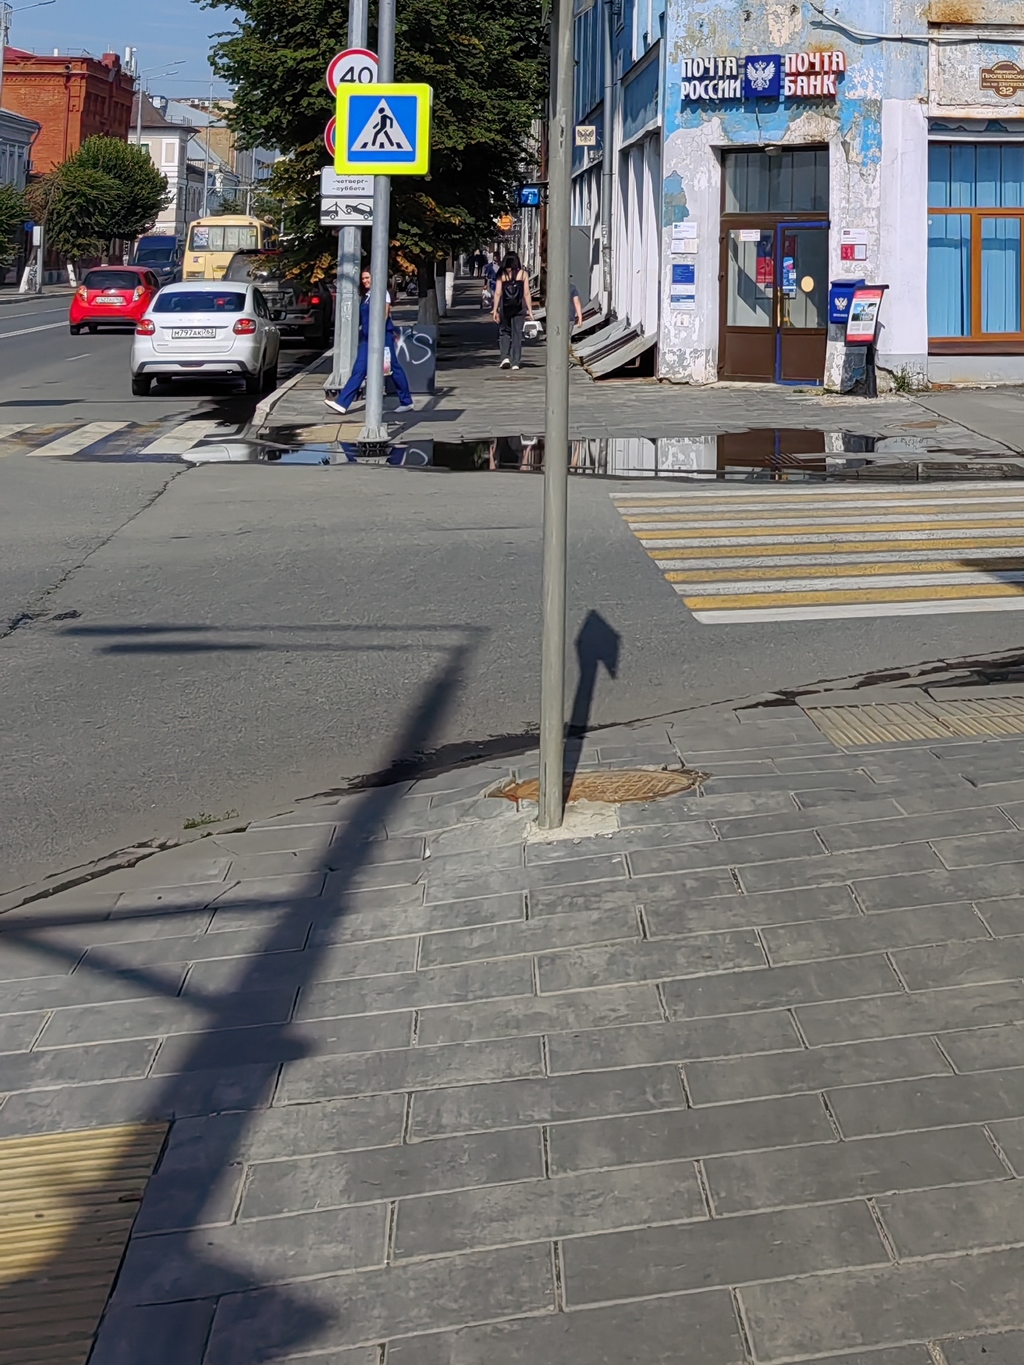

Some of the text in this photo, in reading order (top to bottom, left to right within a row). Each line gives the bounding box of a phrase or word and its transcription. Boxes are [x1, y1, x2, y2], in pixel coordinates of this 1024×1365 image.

[681, 56, 738, 77] ПОЧТА
[785, 51, 845, 74] ПОЧТА
[339, 66, 374, 84] 40
[784, 75, 836, 96] БАНК
[680, 78, 742, 100] РОССИИ
[999, 87, 1014, 95] 32
